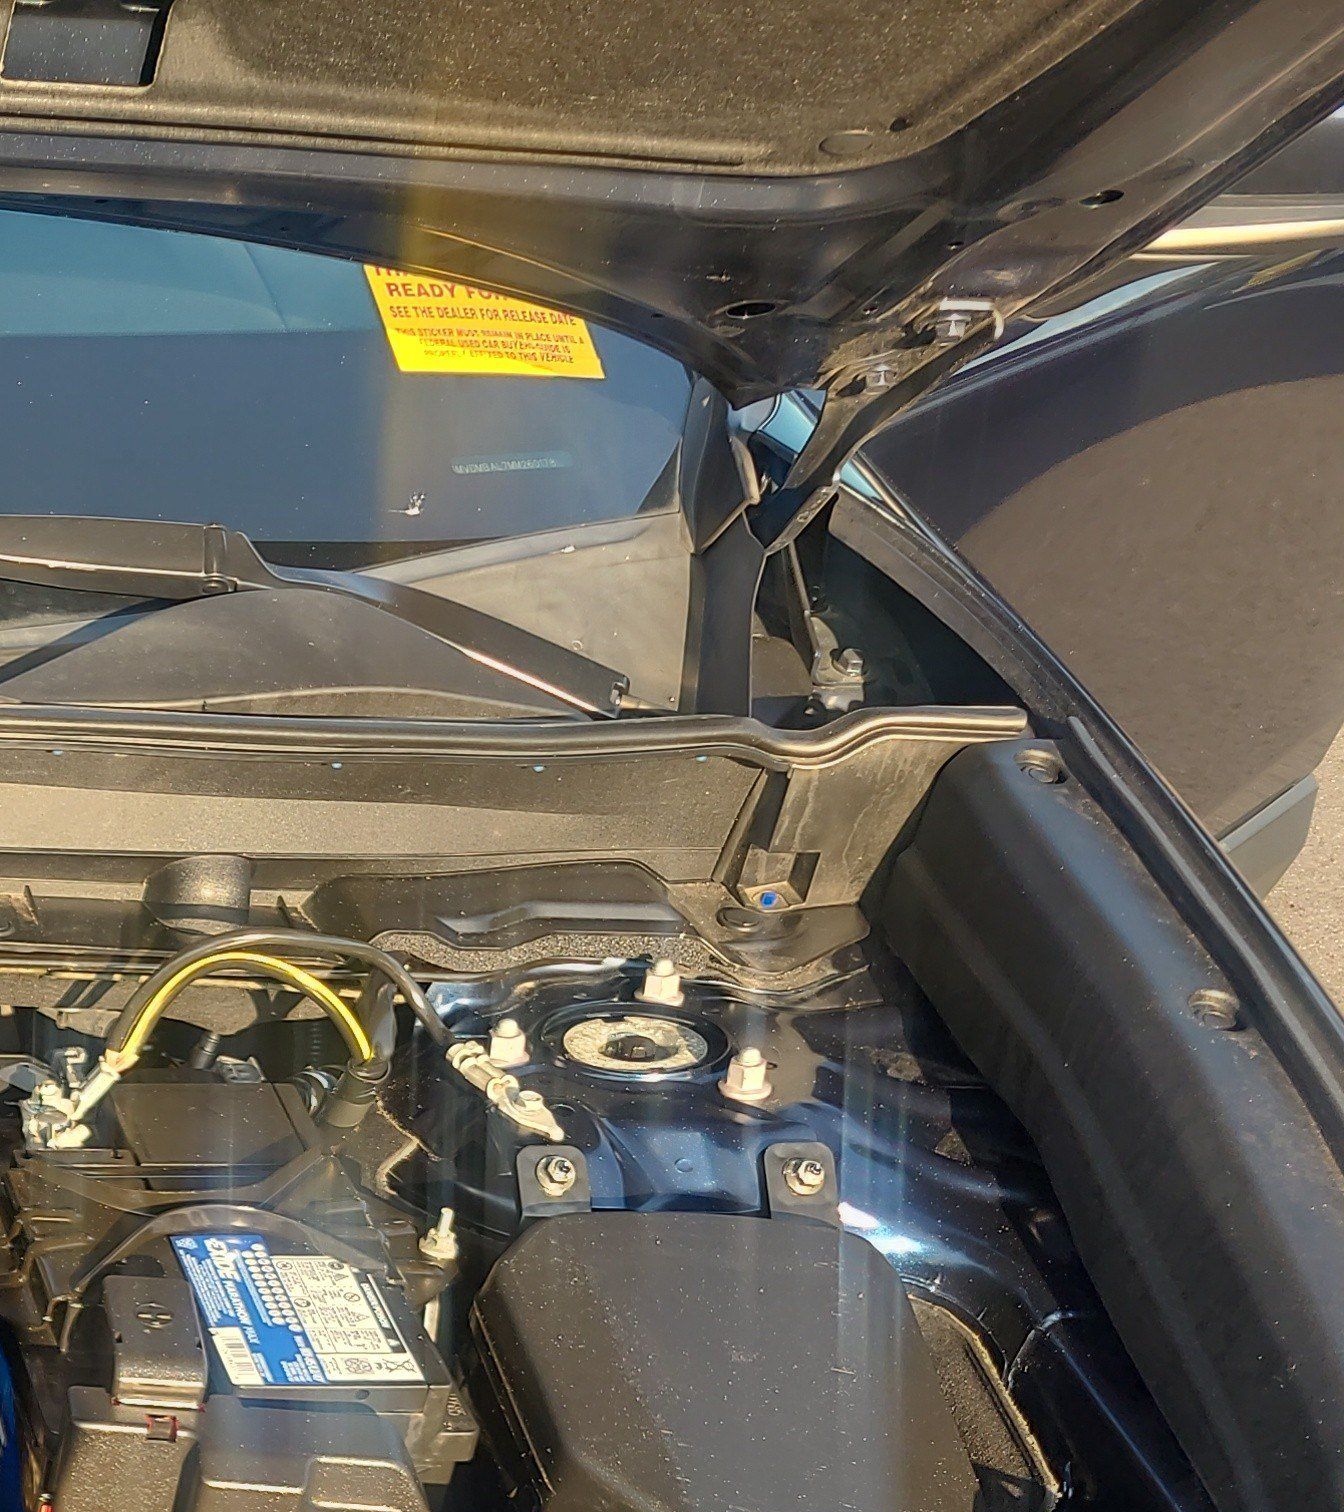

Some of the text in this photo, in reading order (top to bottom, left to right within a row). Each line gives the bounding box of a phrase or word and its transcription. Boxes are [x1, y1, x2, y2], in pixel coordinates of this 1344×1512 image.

[385, 282, 509, 301] READY FO
[389, 305, 577, 326] SEE THE DEALER FOR RELEASE DATE
[417, 328, 454, 337] STICKER
[524, 332, 551, 342] PLACE
[552, 334, 578, 344] UNTIL
[458, 339, 481, 348] USED
[482, 340, 500, 349] CAR
[539, 352, 575, 364] VEHICLE
[222, 1280, 253, 1326] MARATHON
